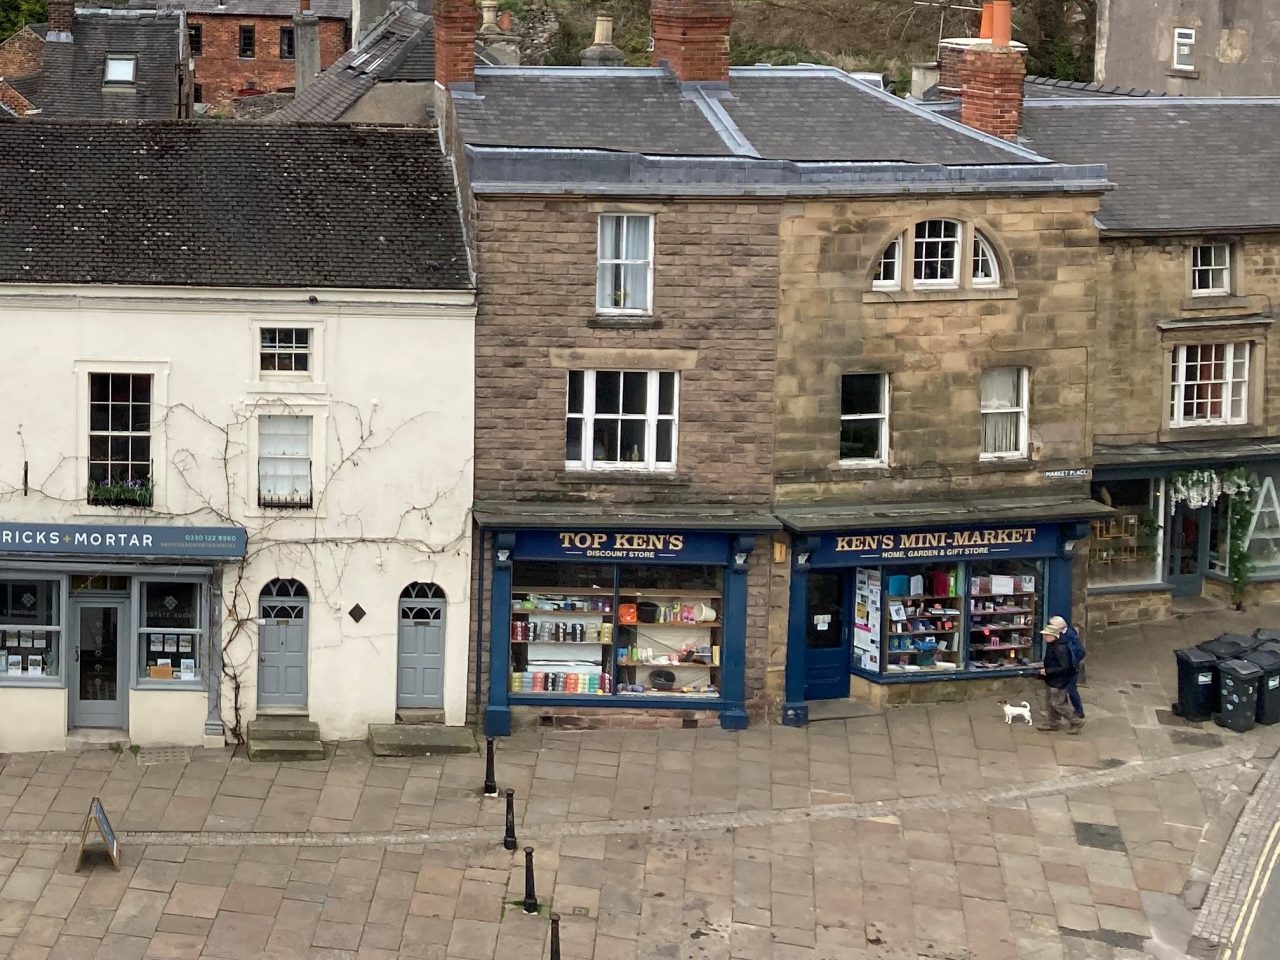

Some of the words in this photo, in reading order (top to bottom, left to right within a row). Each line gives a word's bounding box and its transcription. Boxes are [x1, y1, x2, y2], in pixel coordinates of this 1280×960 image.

[74, 532, 153, 547] MORTAR
[559, 532, 608, 548] TOP
[613, 534, 684, 550] KEN'S
[835, 534, 894, 552] KEN'S
[899, 528, 1036, 548] MINI-MARKET
[586, 550, 627, 558] DISCOUNT
[882, 550, 907, 559] HOME,
[908, 549, 938, 558] GARDEN
[939, 548, 945, 556] &
[946, 547, 963, 556] GIFT
[964, 547, 989, 555] STORE
